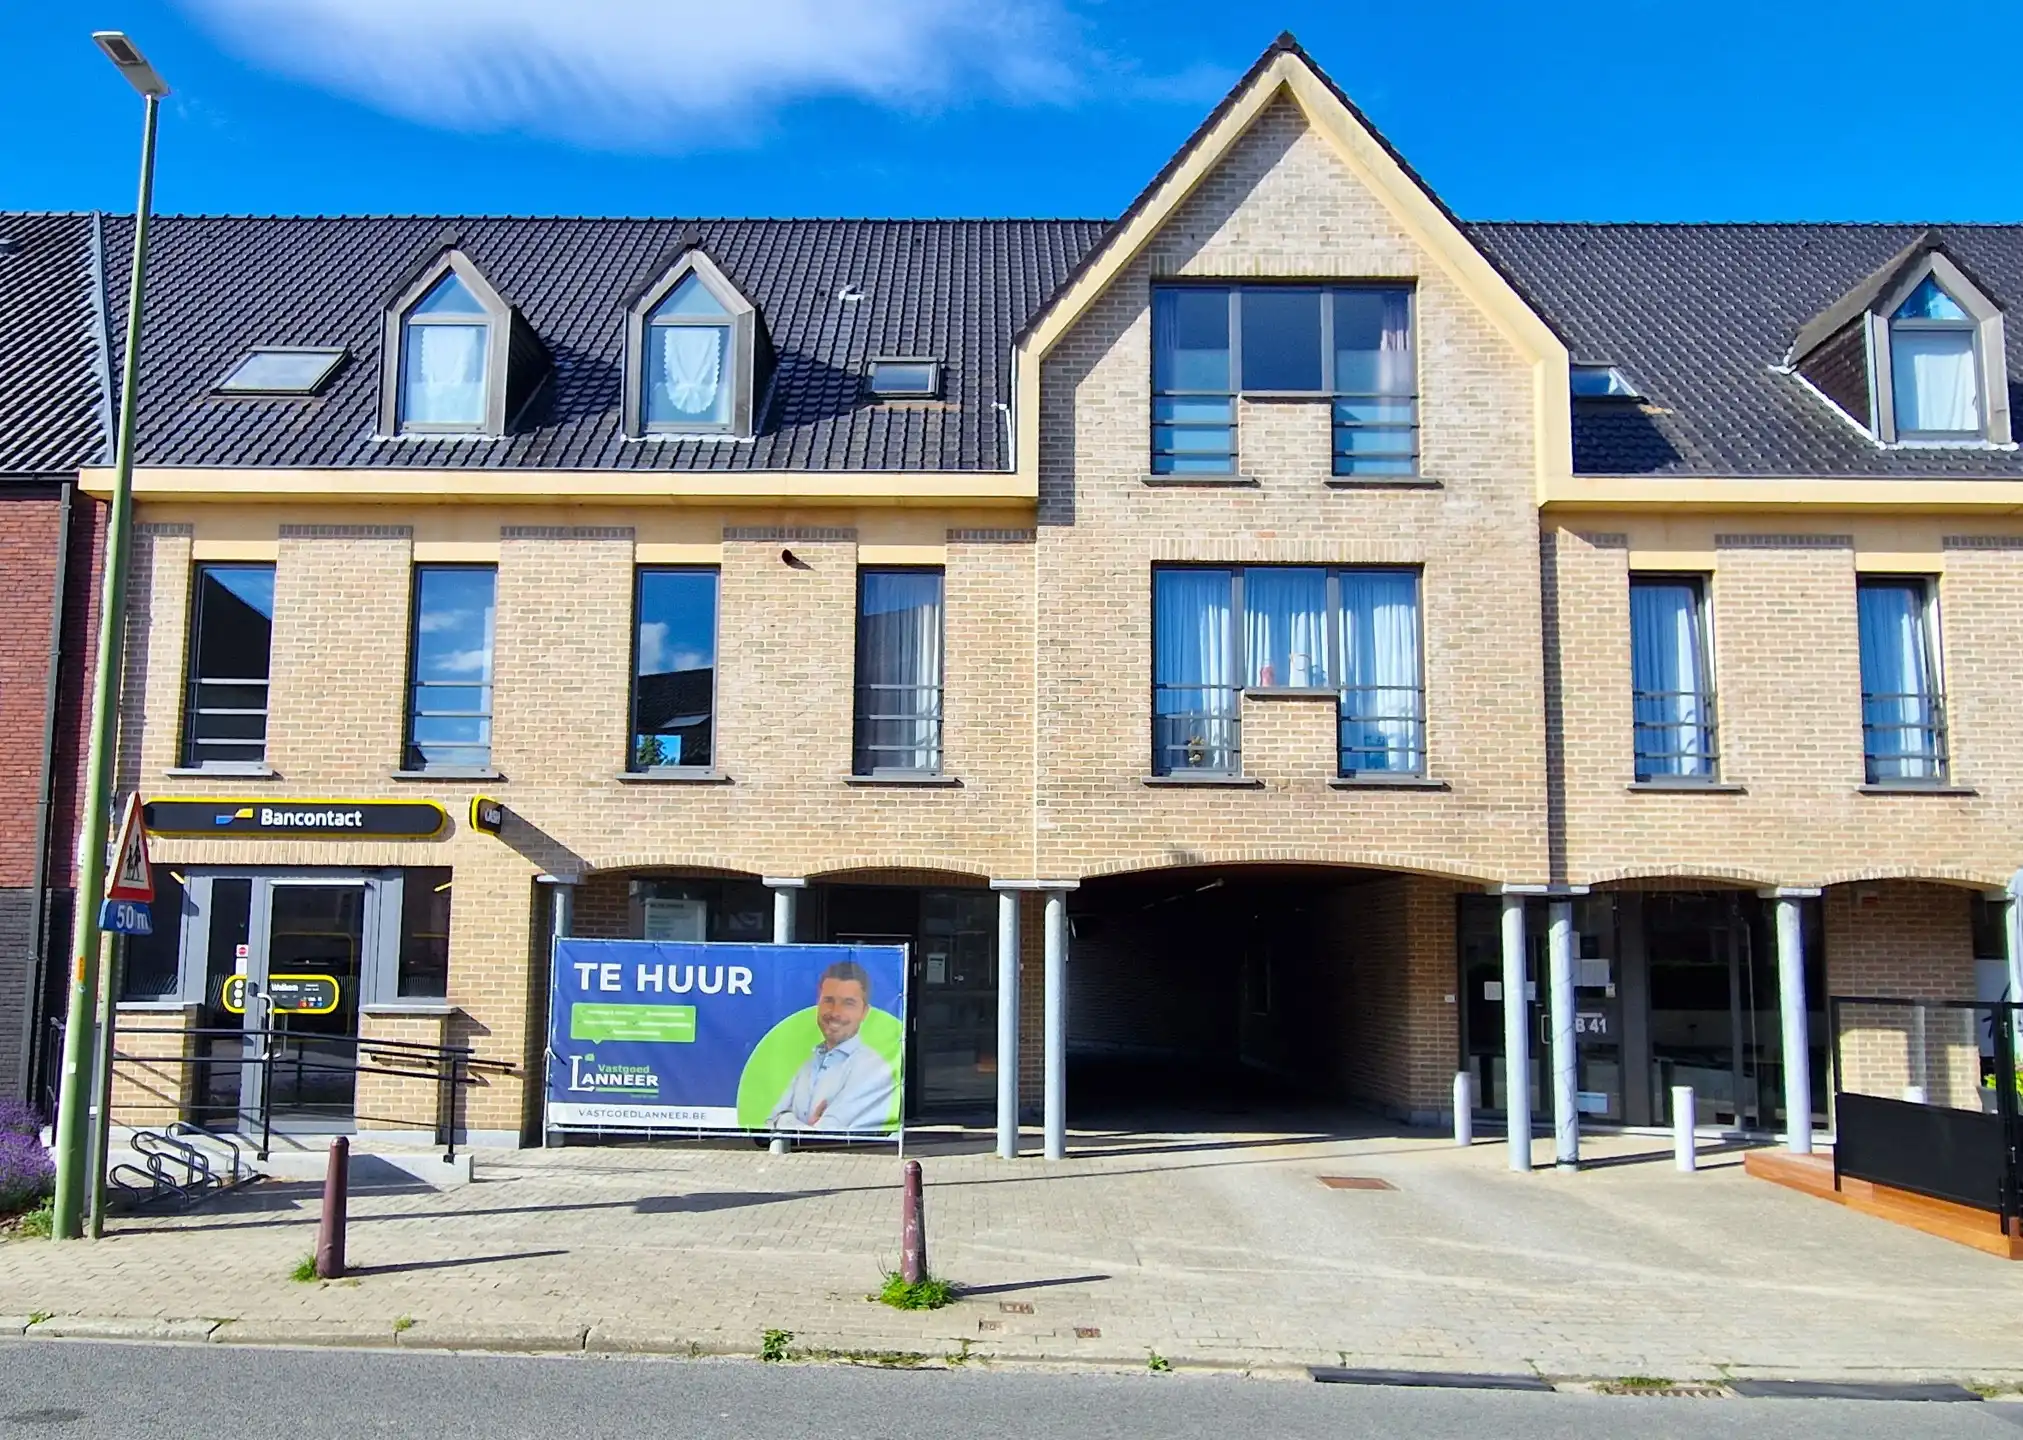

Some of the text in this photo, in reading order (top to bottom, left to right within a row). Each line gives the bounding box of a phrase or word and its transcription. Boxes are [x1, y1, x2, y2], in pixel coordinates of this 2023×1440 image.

[260, 808, 362, 826] Bancontact
[116, 904, 135, 929] 50
[573, 962, 753, 995] TE HUUR
[567, 1055, 660, 1092] LANNEER
[598, 1063, 650, 1075] Vastgoed
[578, 1109, 707, 1120] VASTGOEDLANNEER.BE
